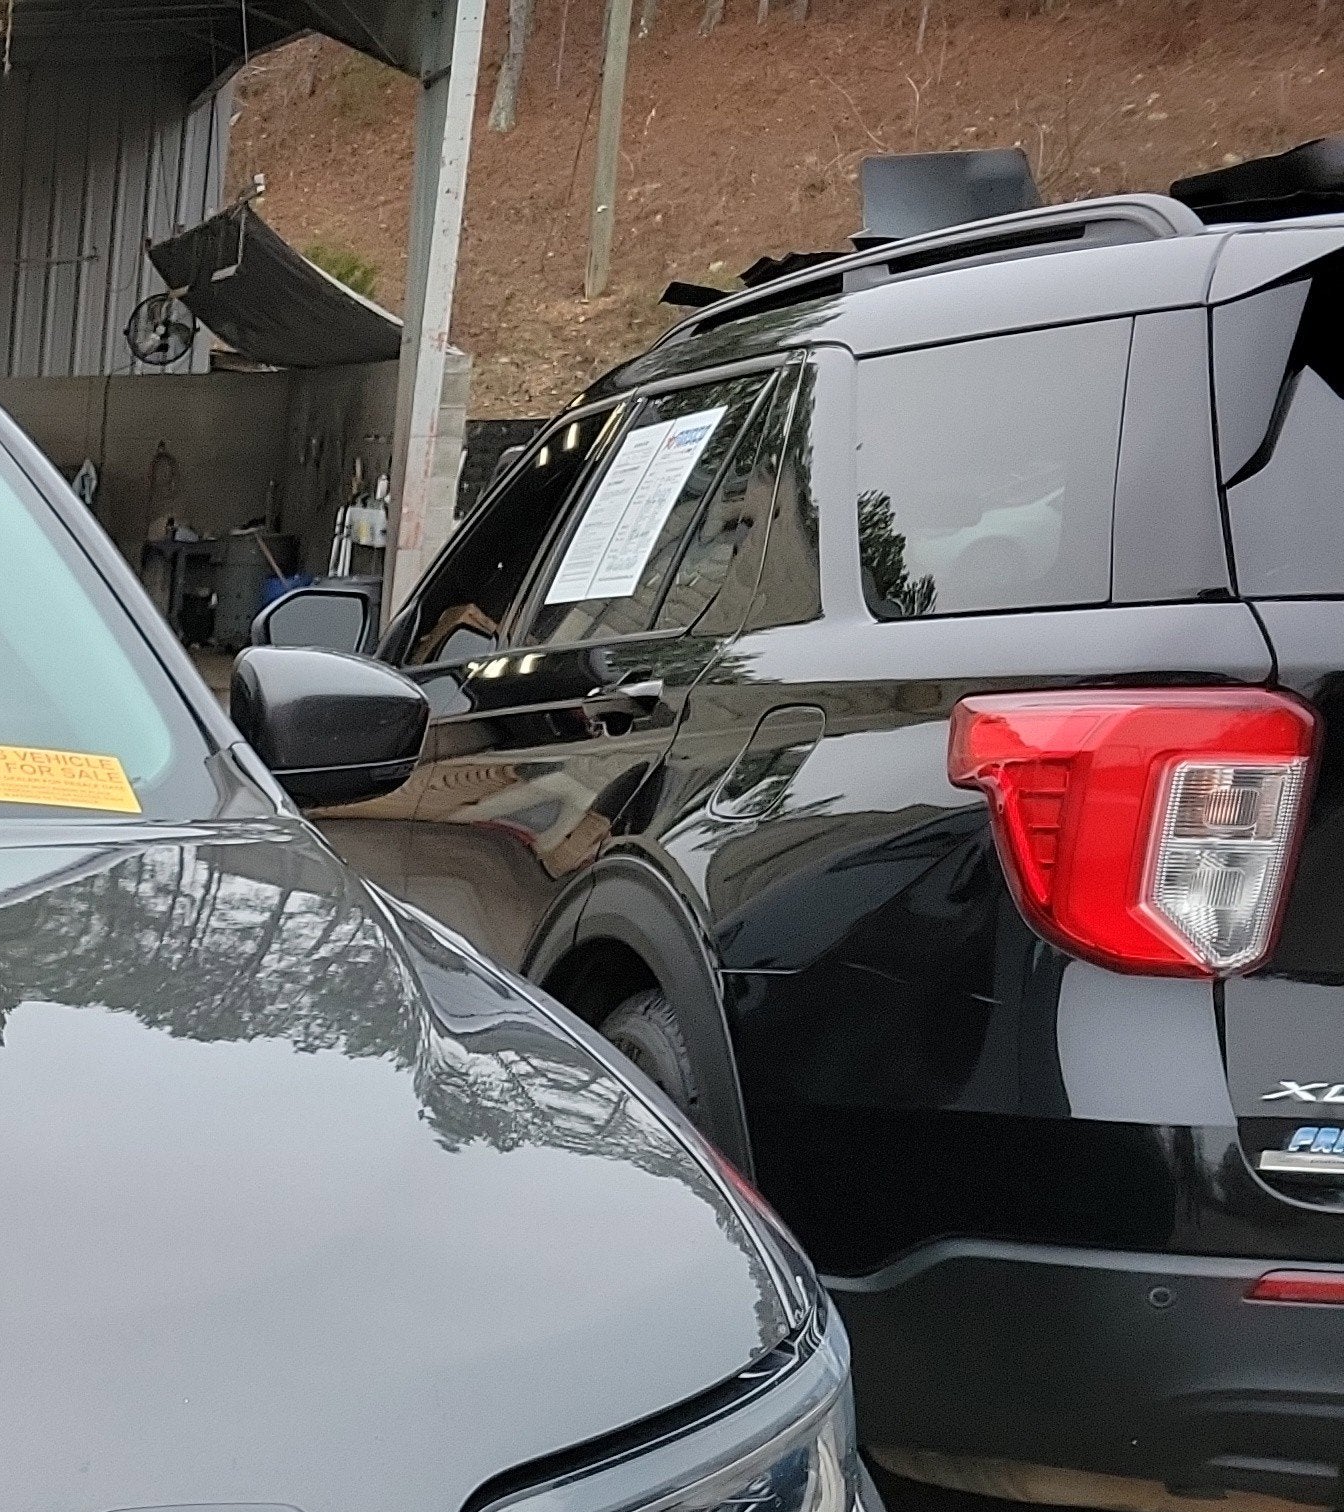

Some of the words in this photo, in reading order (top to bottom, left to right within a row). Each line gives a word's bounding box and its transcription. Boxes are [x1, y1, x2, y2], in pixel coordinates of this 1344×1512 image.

[13, 750, 115, 771] VEHICLE
[5, 762, 54, 777] FOR
[60, 767, 124, 784] SALE
